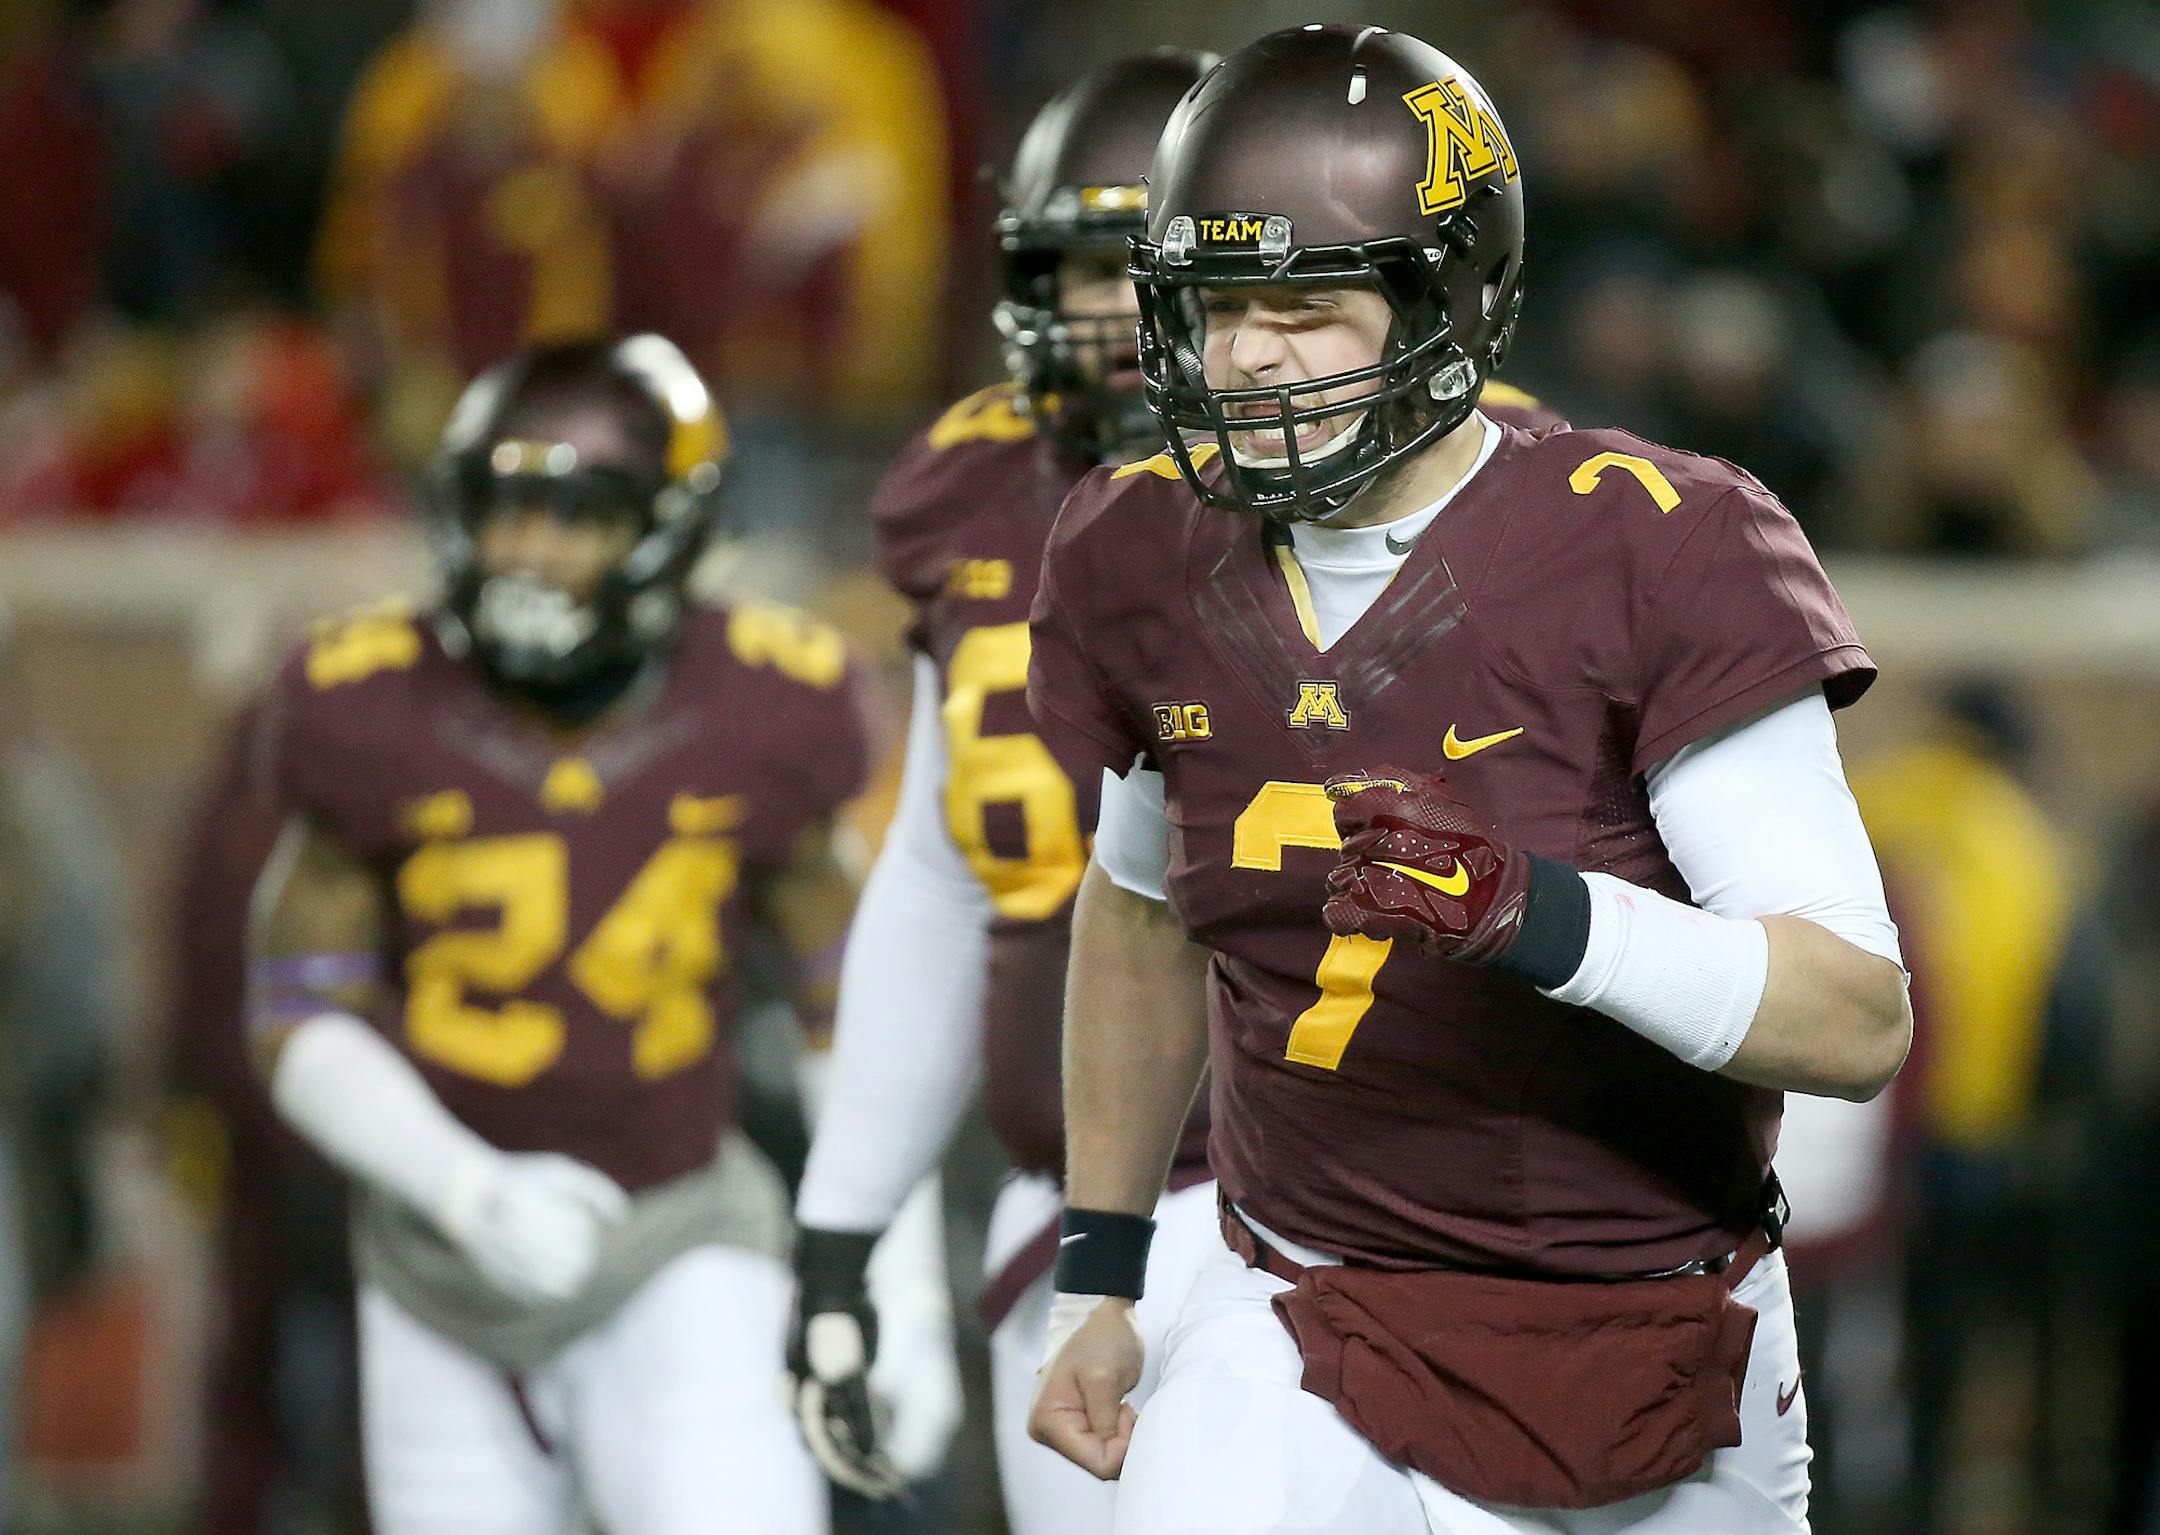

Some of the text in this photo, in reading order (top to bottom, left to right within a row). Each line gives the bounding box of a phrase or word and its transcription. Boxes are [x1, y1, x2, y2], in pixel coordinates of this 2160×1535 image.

[1401, 75, 1519, 216] M
[1200, 219, 1263, 241] TEAM
[1568, 451, 1682, 514] 7
[1288, 682, 1349, 729] M
[941, 621, 1094, 920] 6
[399, 832, 740, 1087] 24
